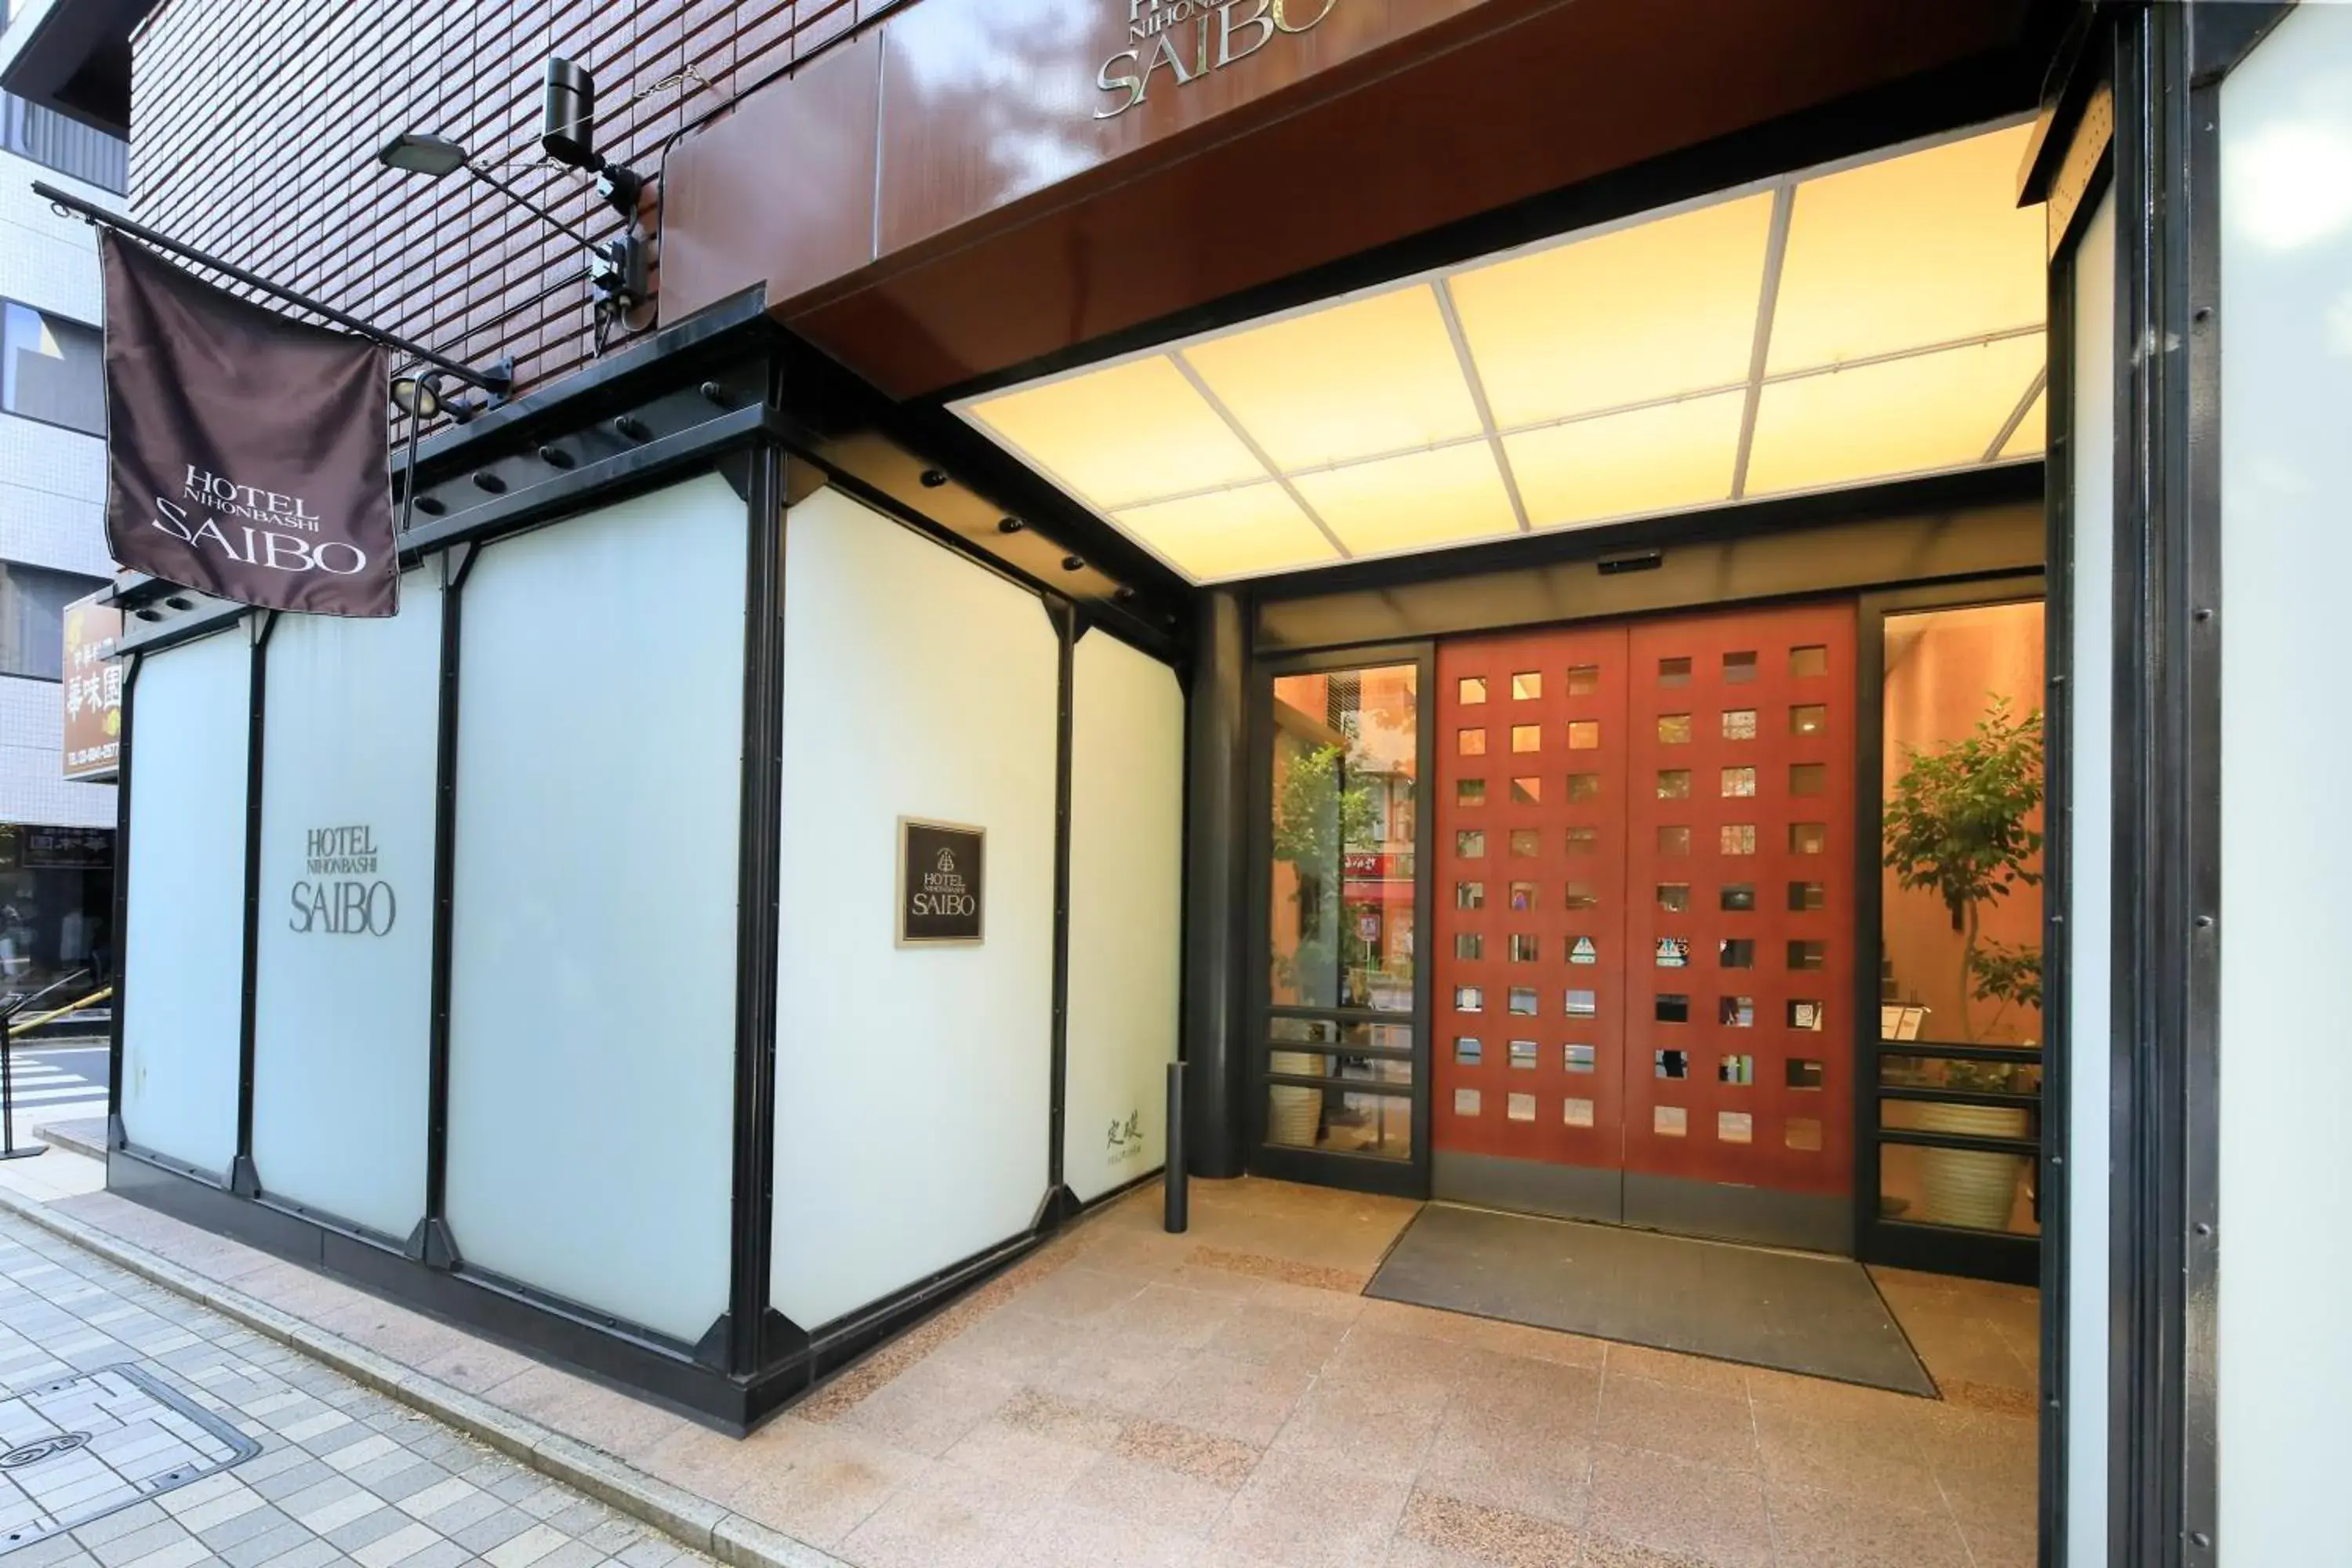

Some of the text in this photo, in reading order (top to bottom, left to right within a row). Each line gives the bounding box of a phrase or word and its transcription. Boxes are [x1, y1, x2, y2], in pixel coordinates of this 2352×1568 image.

[183, 486, 320, 532] NIHONBASHI
[186, 463, 320, 520] HOTEL
[151, 496, 367, 575] SAIBO
[307, 825, 378, 857] HOTEL
[307, 857, 377, 875] NIHONBASHI
[924, 872, 966, 887] HOTEL
[289, 880, 396, 937] SAIBO
[912, 892, 975, 916] SAIBO
